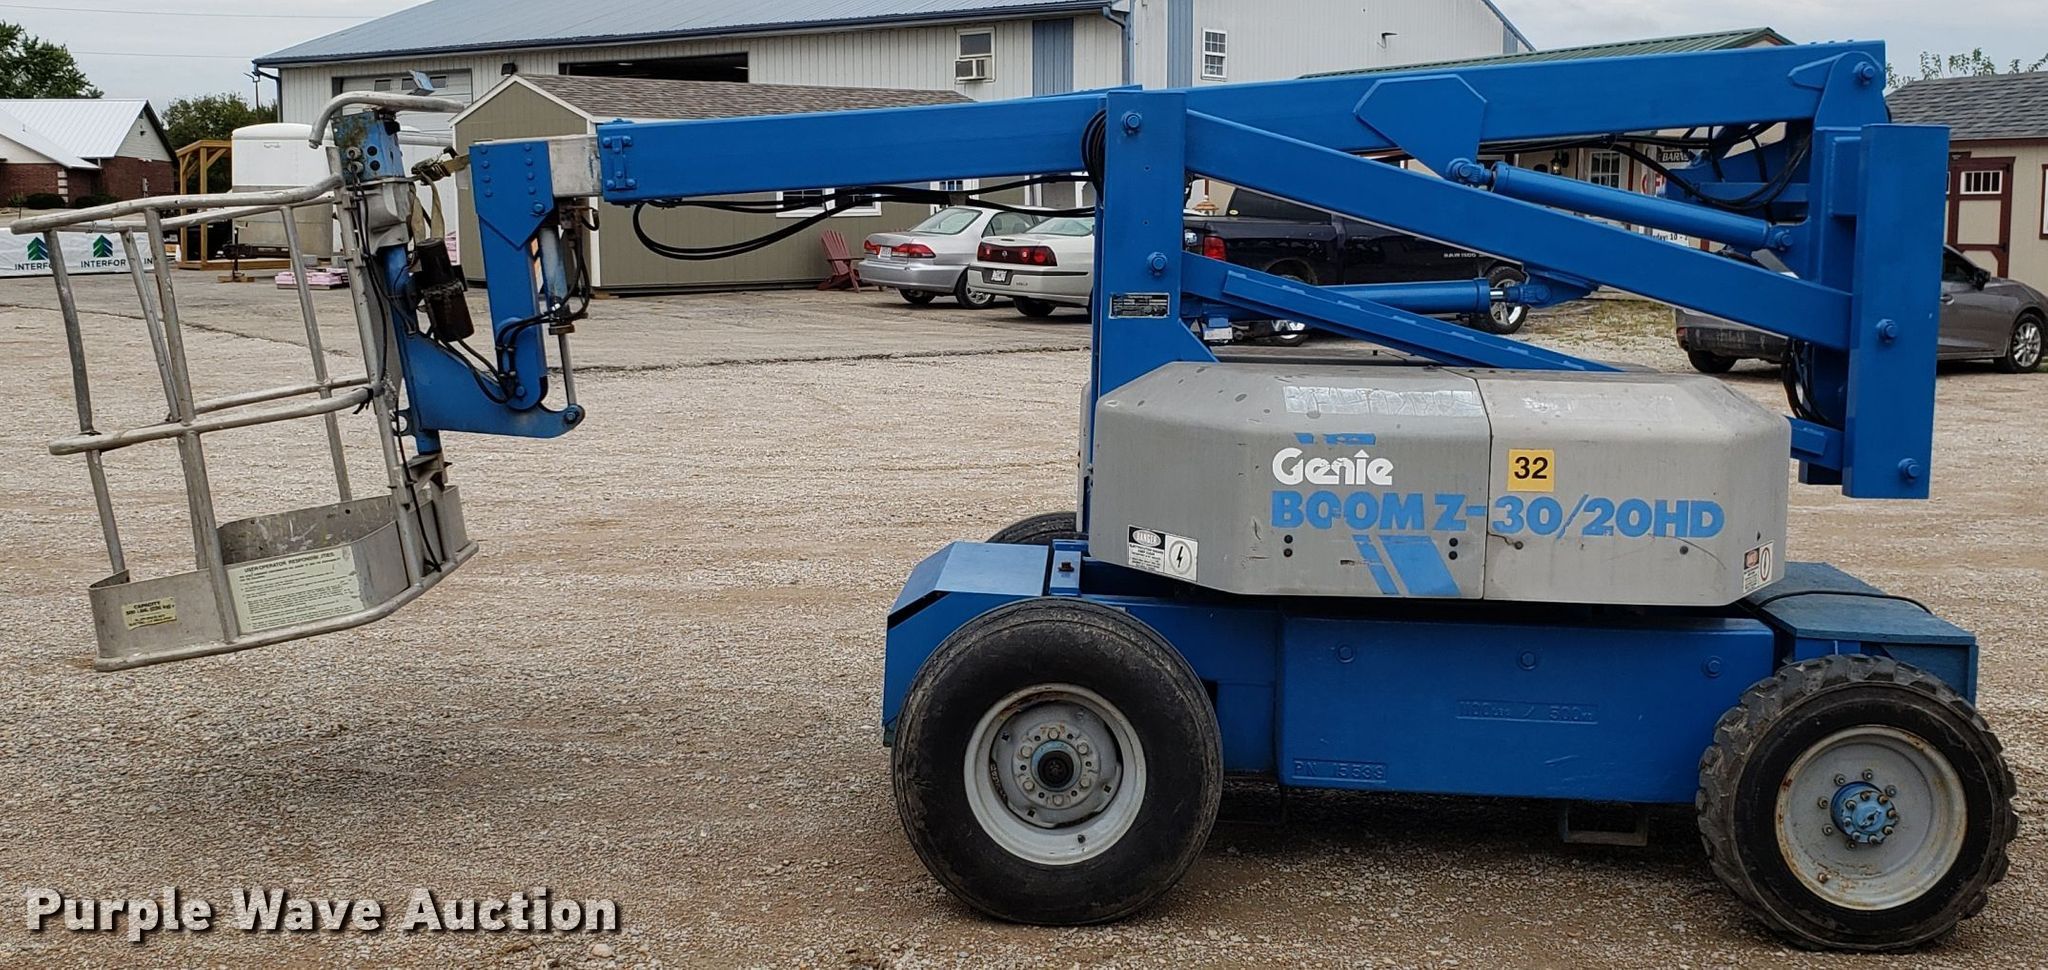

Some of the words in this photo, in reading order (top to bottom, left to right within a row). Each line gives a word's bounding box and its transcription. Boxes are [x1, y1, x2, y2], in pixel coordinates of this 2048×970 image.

[14, 263, 52, 271] INTERF
[80, 258, 126, 268] INTERFOR
[1272, 447, 1394, 486] Genie
[1513, 456, 1548, 480] 32
[1271, 490, 1425, 530] BOOM
[1433, 493, 1725, 539] Z-30/20HD
